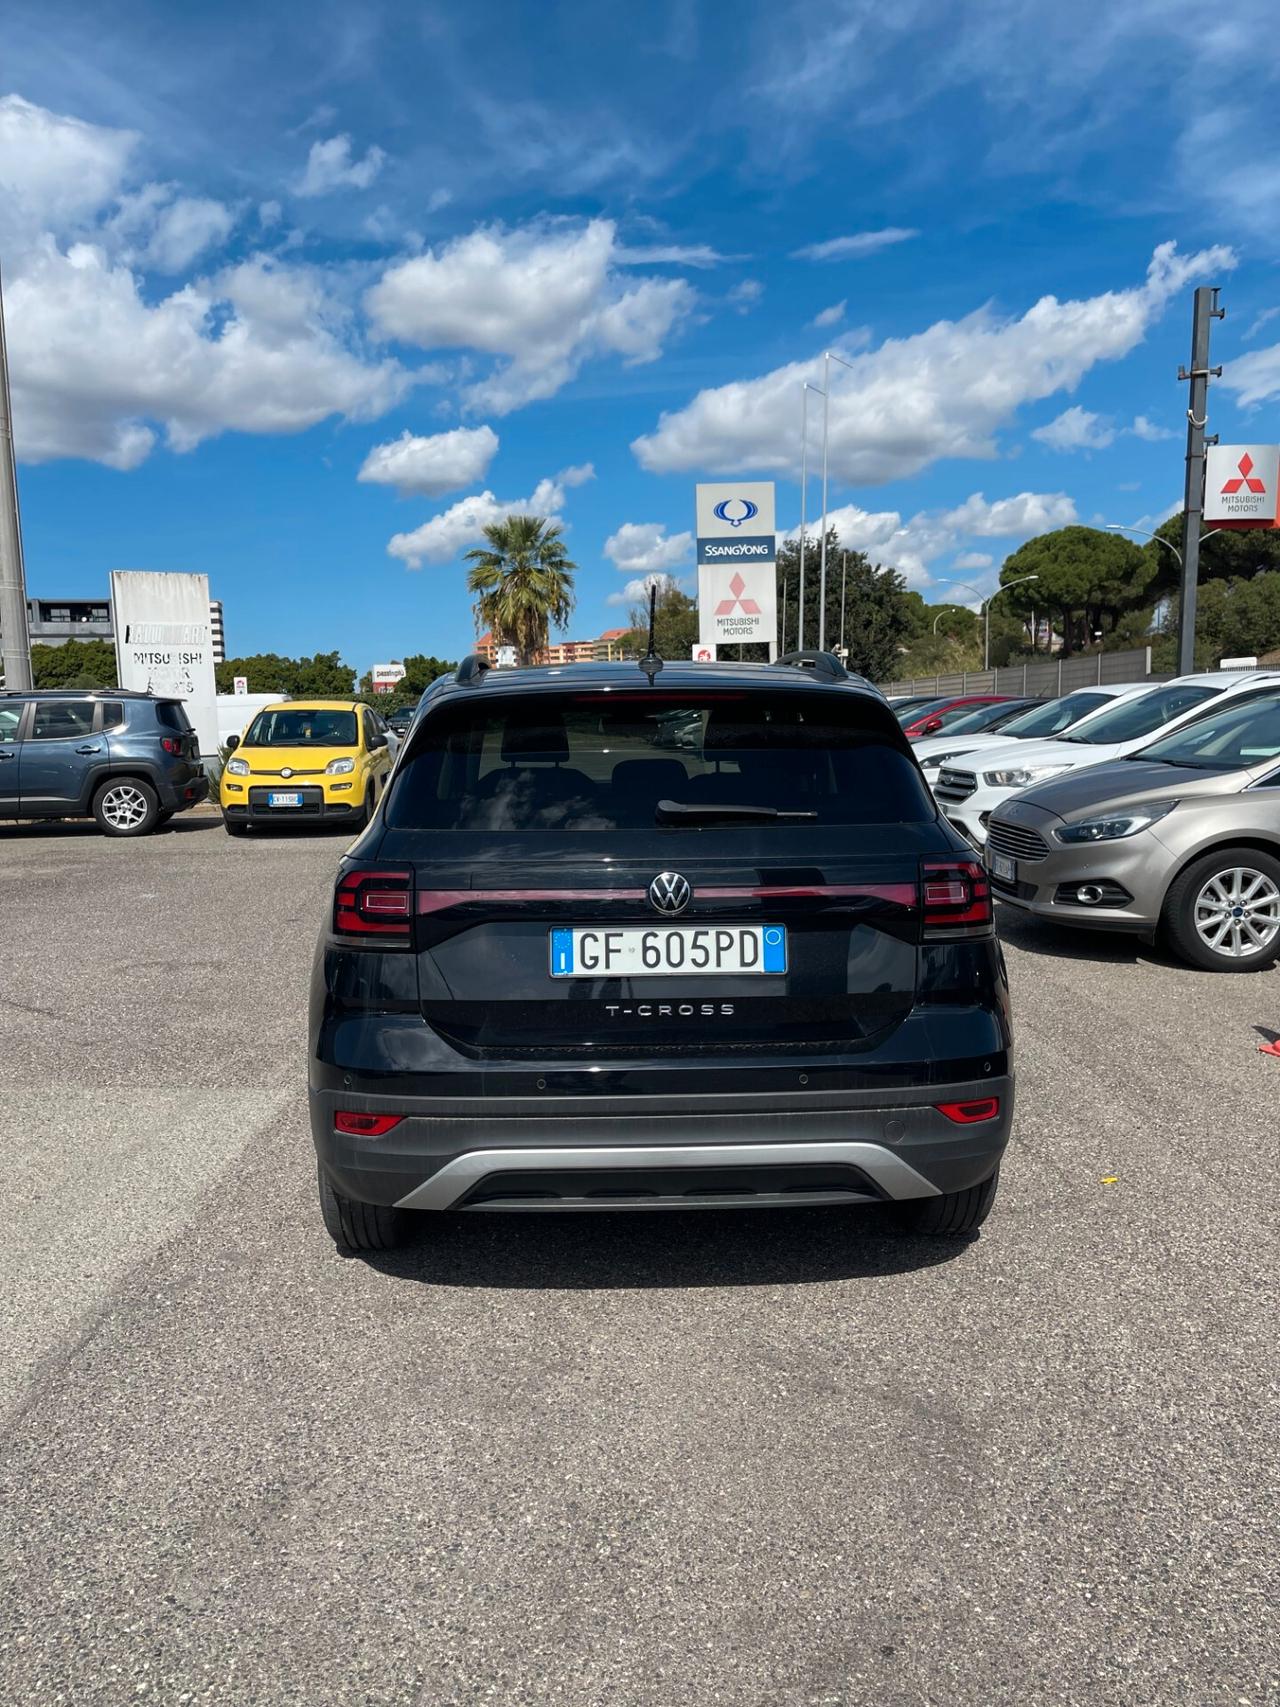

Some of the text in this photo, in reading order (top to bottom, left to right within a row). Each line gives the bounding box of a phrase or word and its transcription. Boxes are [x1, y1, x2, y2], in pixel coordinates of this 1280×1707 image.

[1221, 496, 1265, 504] MITSUBISHI
[717, 617, 760, 627] MITSUBISHI
[723, 627, 753, 636] MOTORS
[580, 932, 624, 970] GF
[641, 930, 759, 969] 605PD
[605, 1004, 736, 1017] T-CROSS
